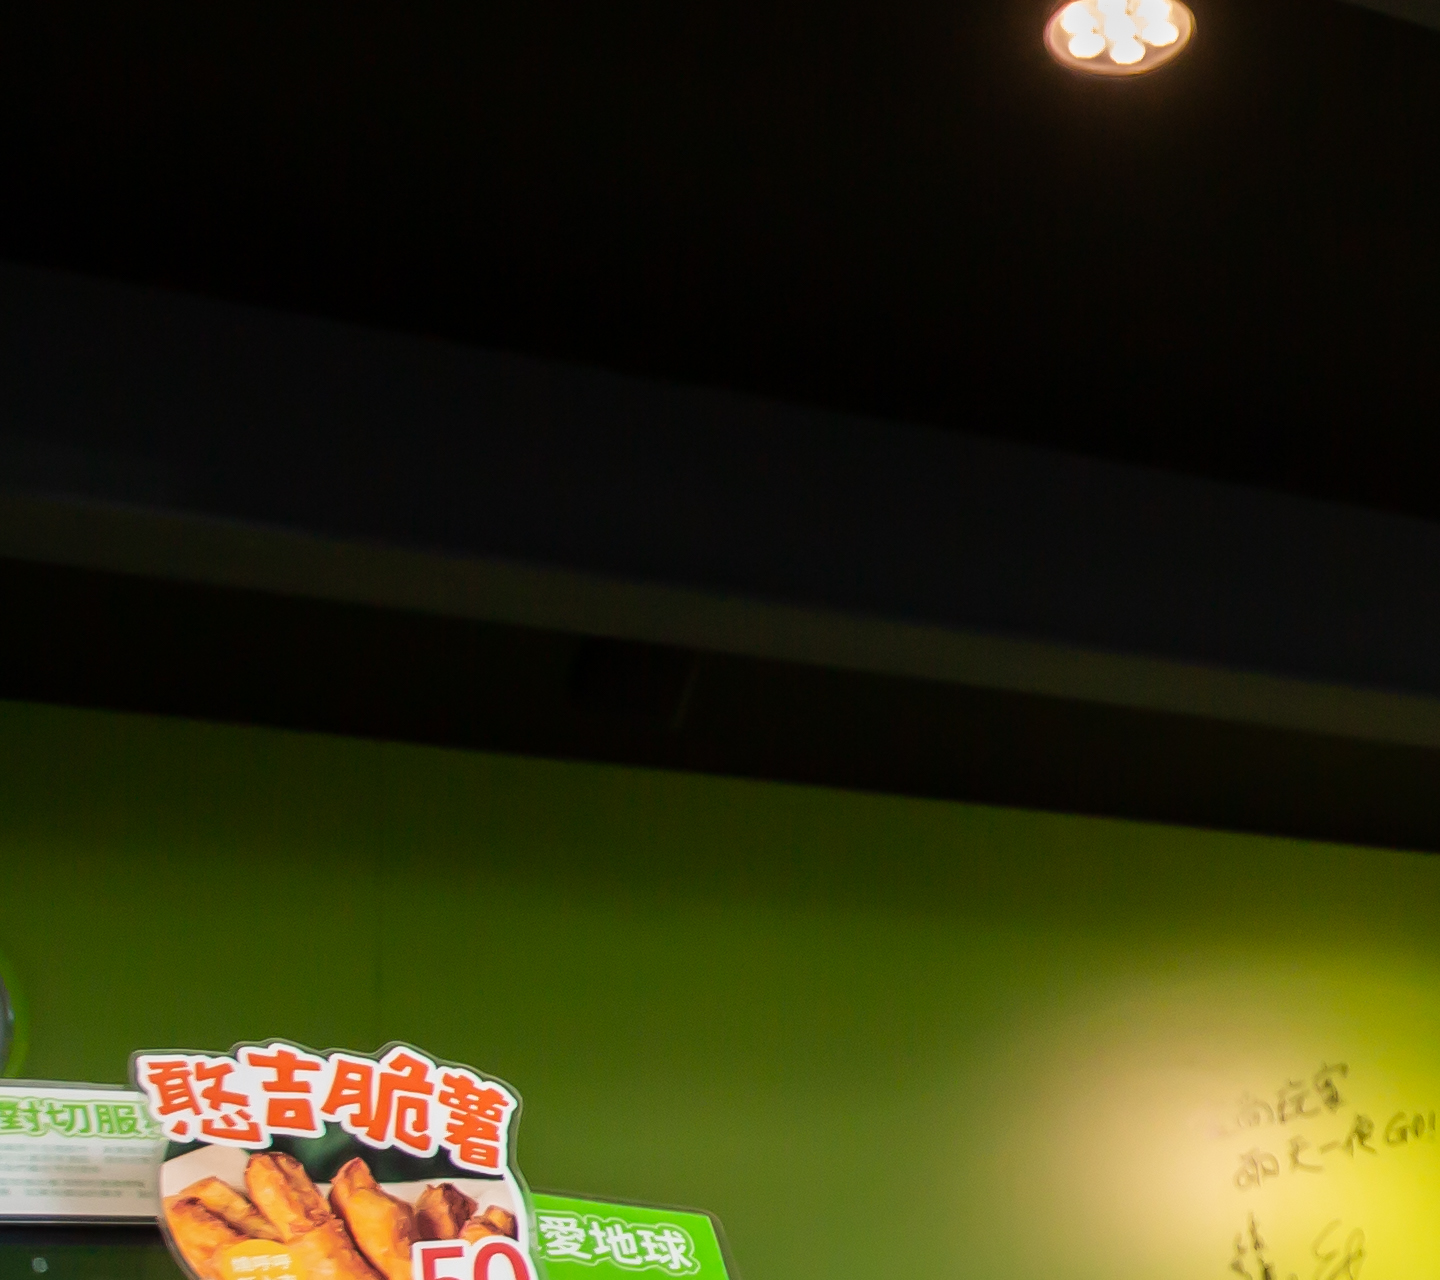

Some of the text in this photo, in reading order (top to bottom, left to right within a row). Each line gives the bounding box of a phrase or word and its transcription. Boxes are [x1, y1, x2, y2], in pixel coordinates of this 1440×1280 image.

[0, 1101, 157, 1136] 對切服
[146, 1048, 511, 1169] 憨吉脆薯
[538, 1216, 691, 1270] 愛地球
